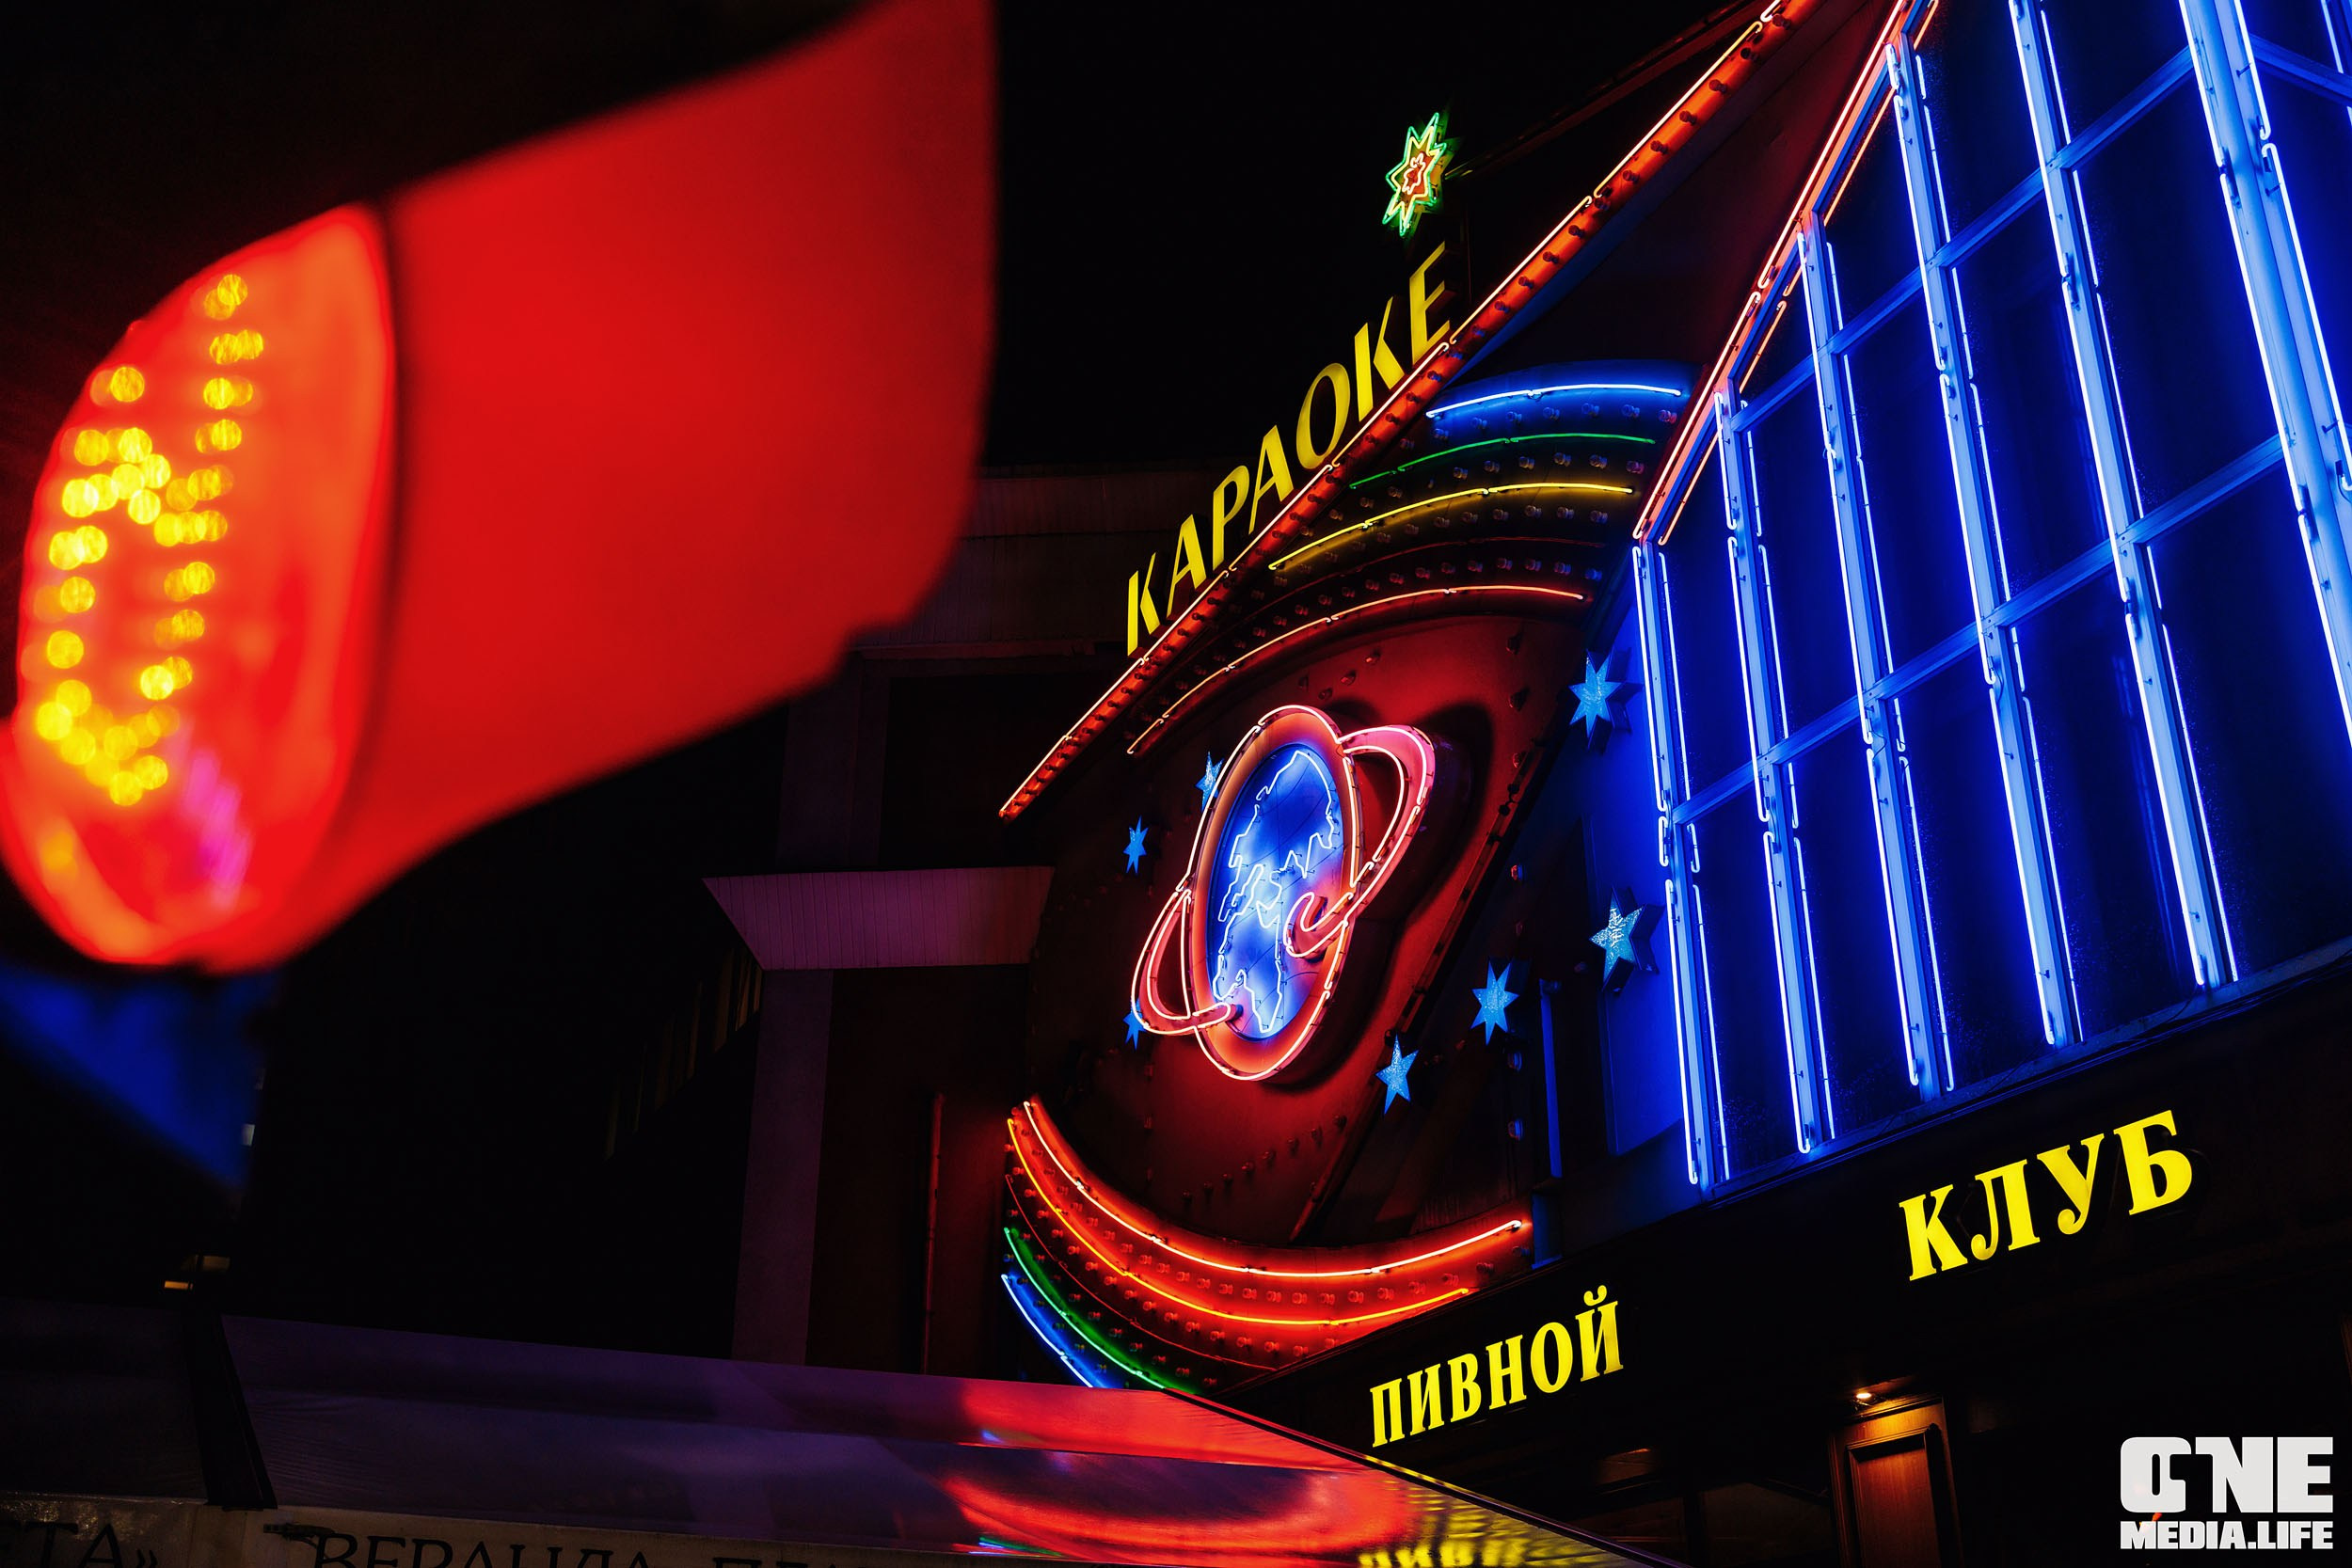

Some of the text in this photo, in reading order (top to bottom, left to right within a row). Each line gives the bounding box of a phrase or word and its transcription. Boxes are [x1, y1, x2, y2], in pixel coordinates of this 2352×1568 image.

[1127, 241, 1450, 657] КАРАОКЕ
[1370, 1110, 2193, 1448] ПИВНОЙ КЛУБ
